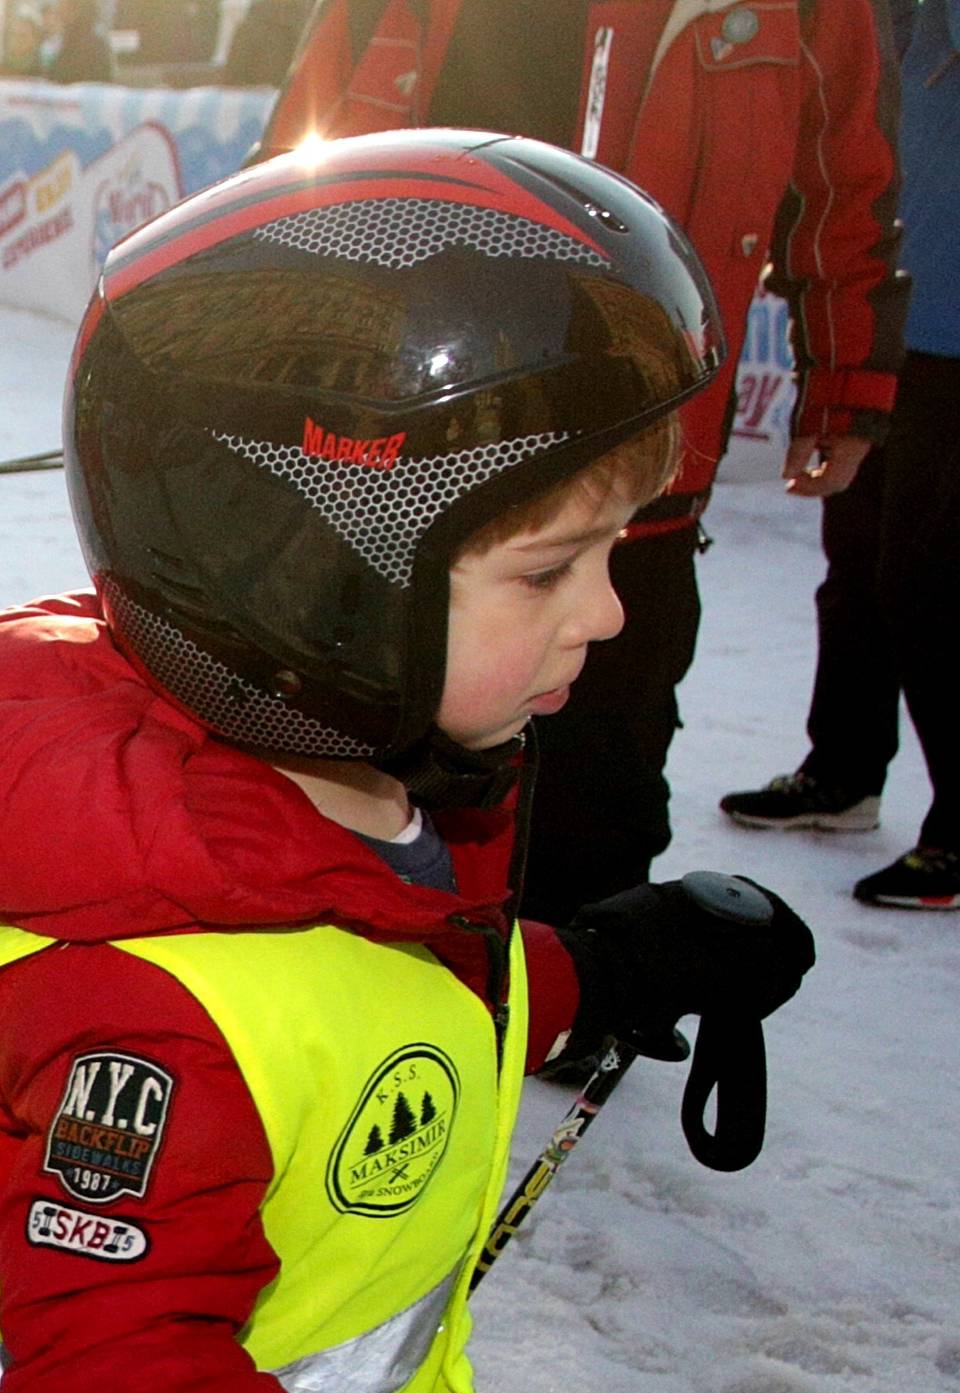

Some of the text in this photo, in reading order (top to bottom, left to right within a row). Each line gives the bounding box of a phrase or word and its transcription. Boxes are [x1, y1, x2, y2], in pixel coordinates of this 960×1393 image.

[302, 416, 408, 472] MARKER
[62, 1061, 164, 1136] N.Y.C
[54, 1119, 151, 1160] BACKFLIP
[349, 1119, 447, 1185] MAKSIMIR
[72, 1167, 112, 1192] 1987
[52, 1209, 111, 1250] SKB
